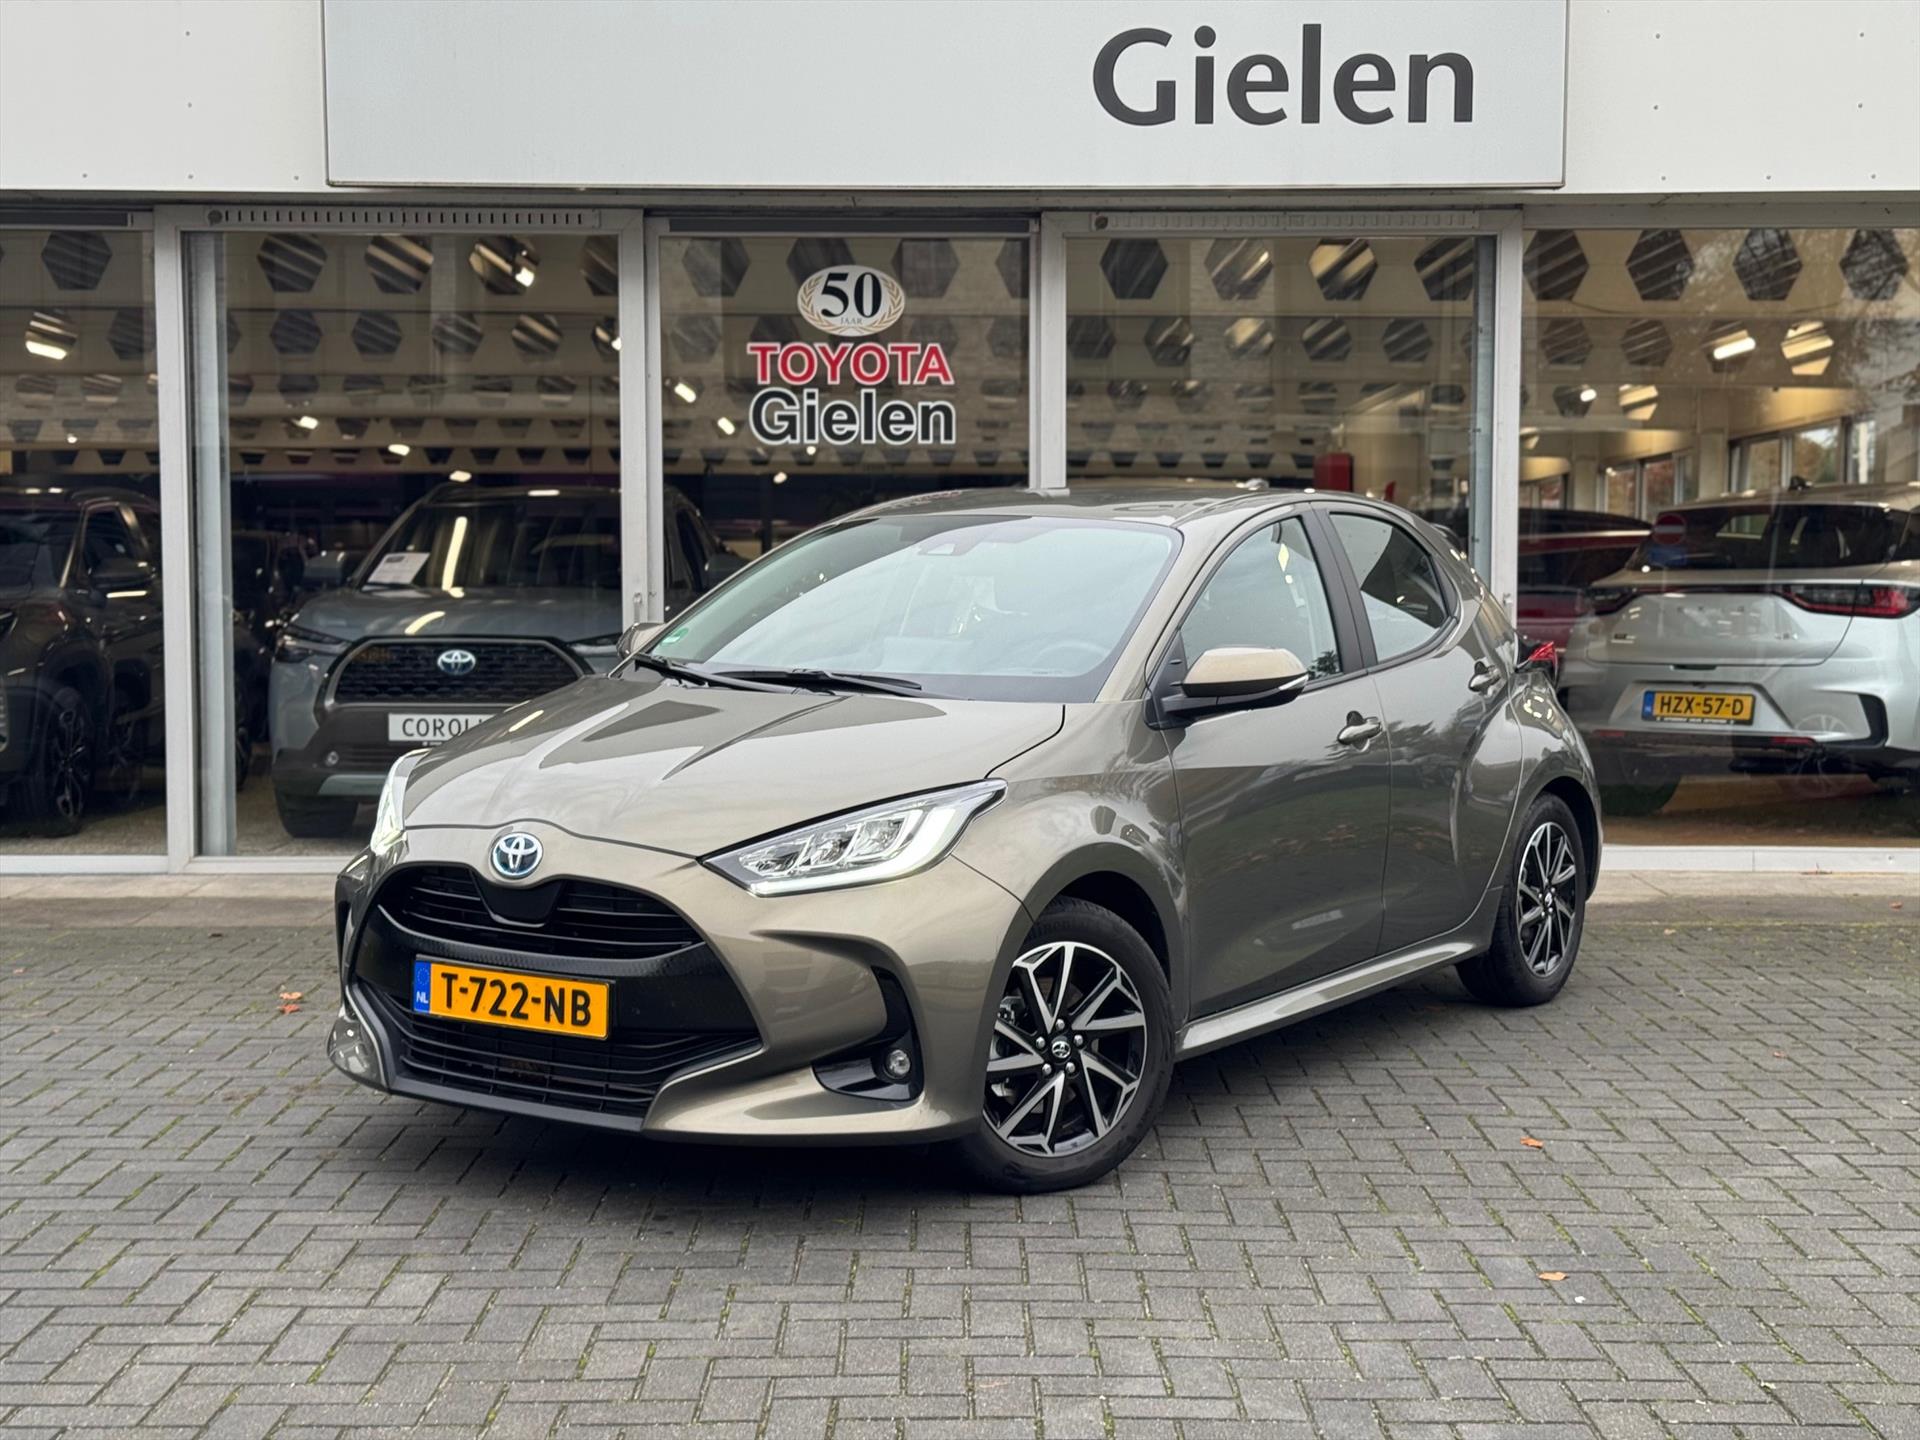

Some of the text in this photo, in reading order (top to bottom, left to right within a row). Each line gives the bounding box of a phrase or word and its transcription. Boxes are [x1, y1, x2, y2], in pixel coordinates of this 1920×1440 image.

[1093, 24, 1474, 126] Gielen
[820, 272, 882, 318] 50
[839, 316, 863, 326] JAAR
[747, 342, 955, 385] TOYOTA
[749, 387, 956, 445] Gielen
[1659, 694, 1744, 716] HZX-57-D
[401, 717, 482, 737] COROL
[416, 990, 429, 1004] NL
[440, 972, 591, 1027] T-722-NB
